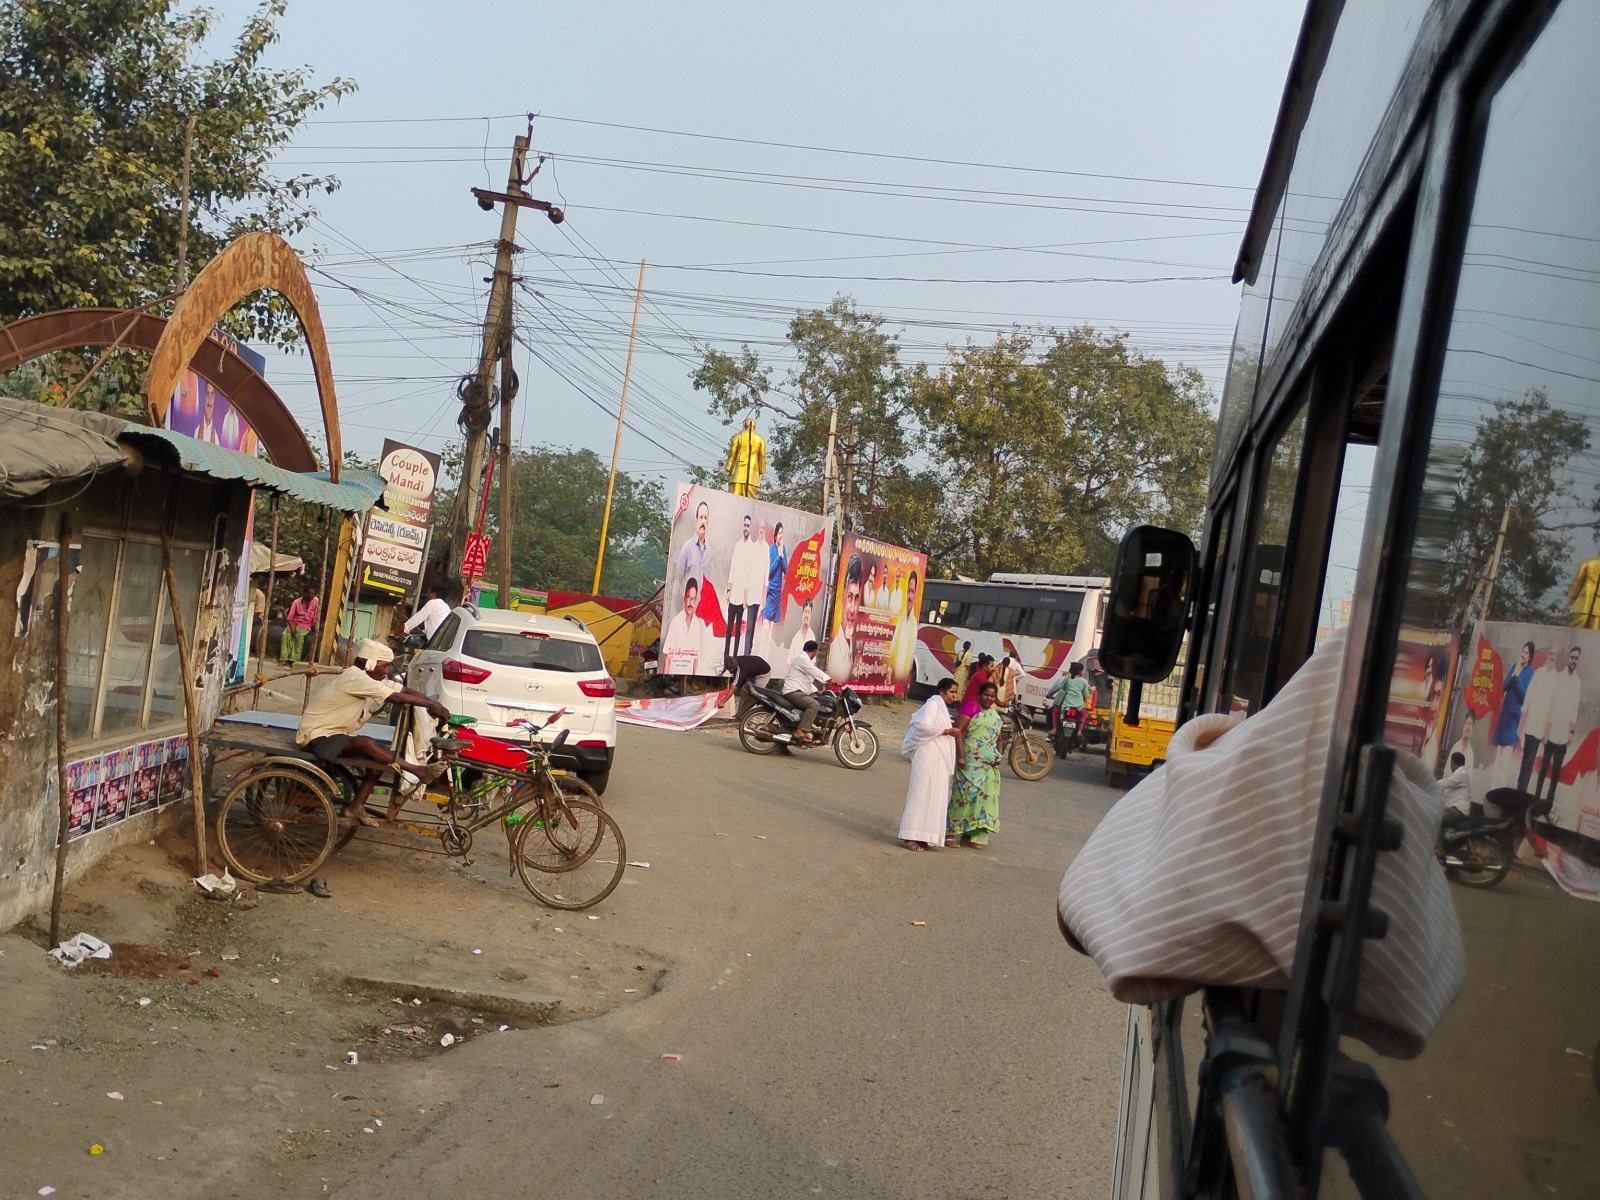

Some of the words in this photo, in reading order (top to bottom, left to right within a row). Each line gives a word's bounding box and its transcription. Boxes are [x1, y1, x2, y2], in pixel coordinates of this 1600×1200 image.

[391, 454, 429, 476] Couple
[389, 472, 425, 493] Mandi
[383, 490, 397, 502] mily
